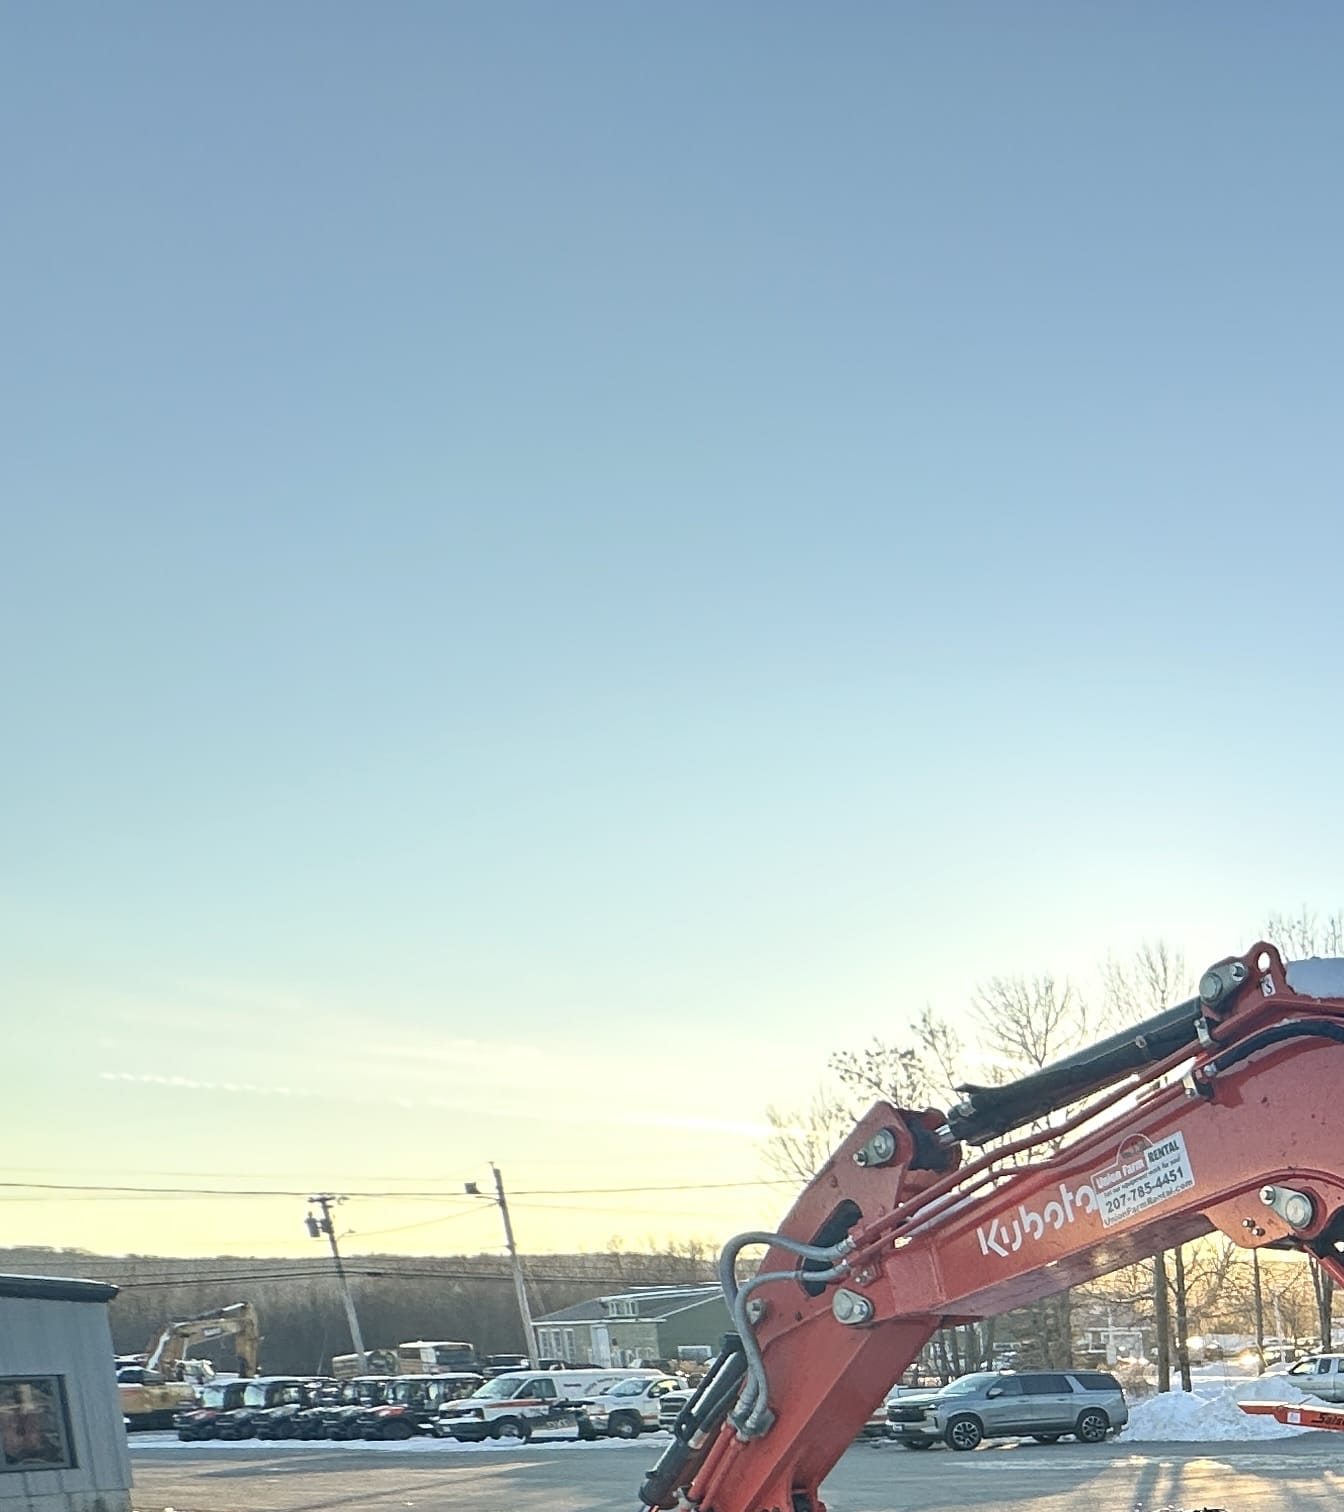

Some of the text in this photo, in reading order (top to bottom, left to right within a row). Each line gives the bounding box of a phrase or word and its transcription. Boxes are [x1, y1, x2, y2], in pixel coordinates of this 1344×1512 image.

[1147, 1140, 1180, 1162] RENTAL
[1105, 1166, 1185, 1214] 207-785-4451
[976, 1183, 1099, 1258] Kubota
